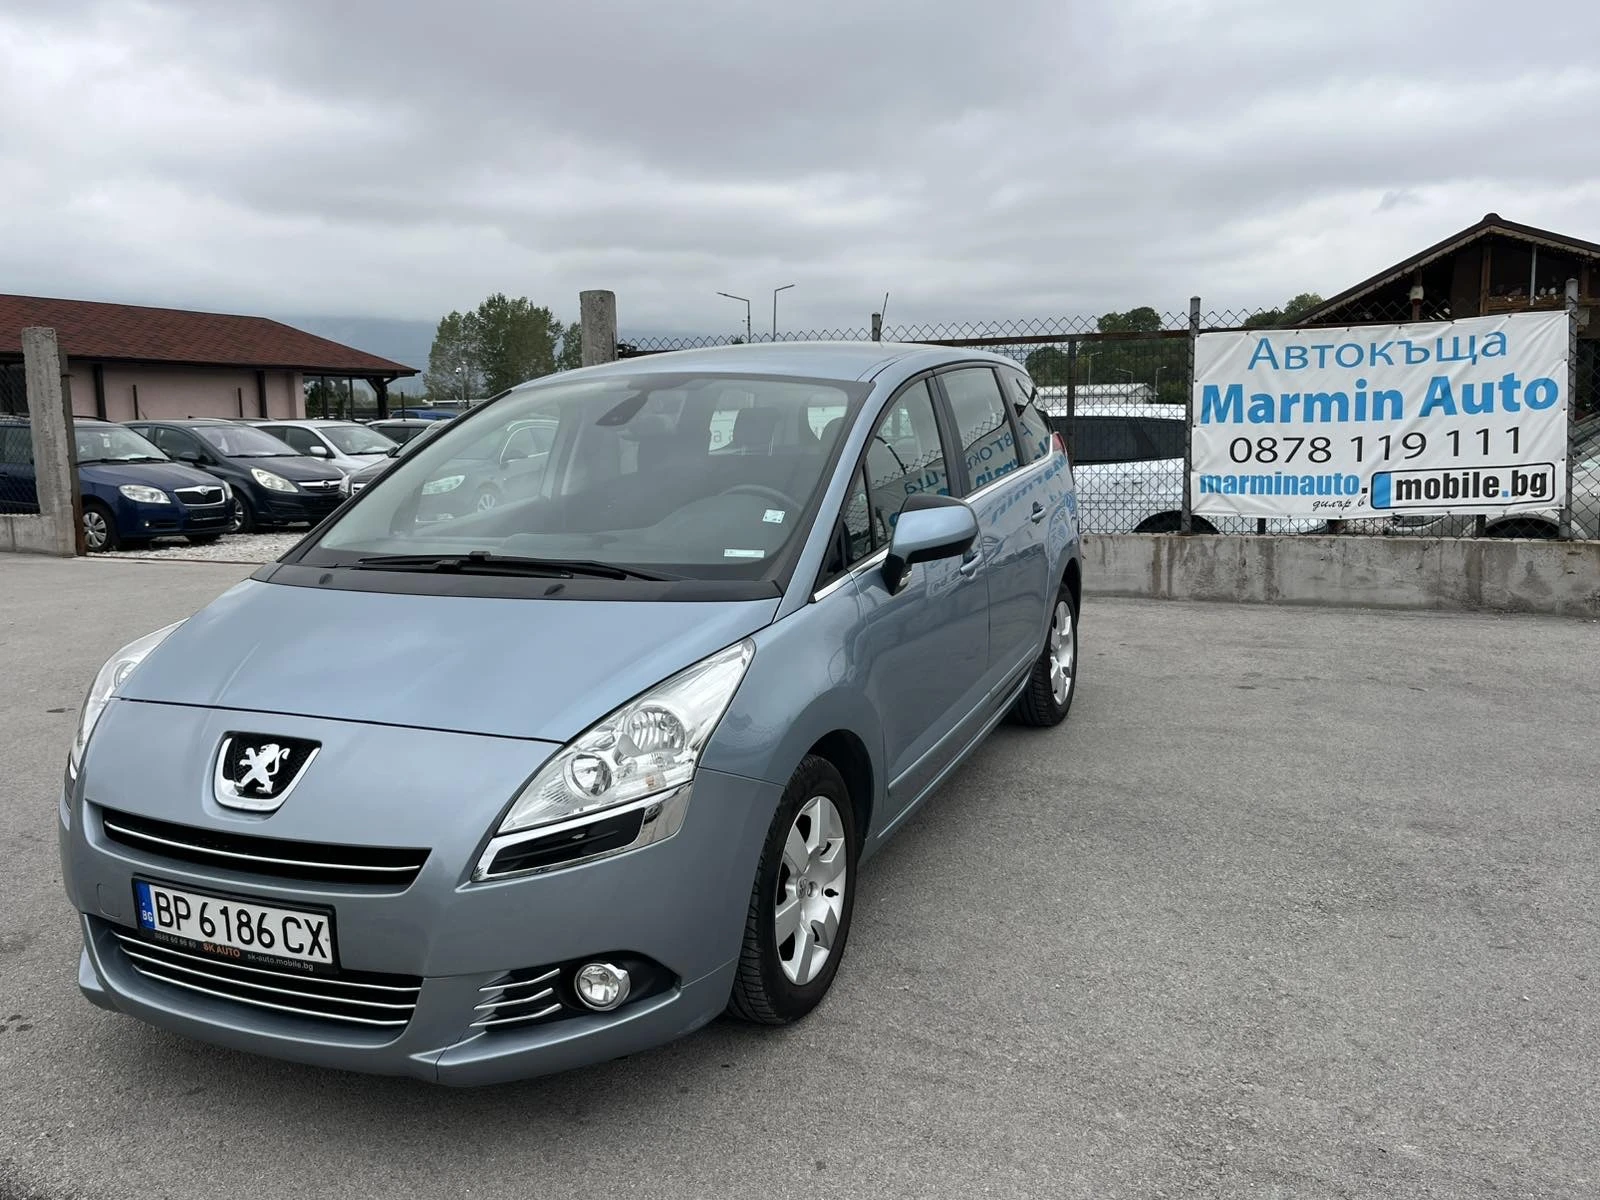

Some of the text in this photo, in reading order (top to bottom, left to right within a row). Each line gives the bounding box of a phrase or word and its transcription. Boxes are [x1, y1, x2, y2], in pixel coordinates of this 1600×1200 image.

[1248, 331, 1507, 370] Автокъща
[1200, 372, 1559, 425] Marmin Auto
[1229, 426, 1520, 464] 0878 119 111
[1396, 470, 1547, 500] mobile.bg
[142, 910, 153, 922] BG
[155, 891, 328, 958] BP 6186 CX
[203, 943, 240, 958] SK AUTO
